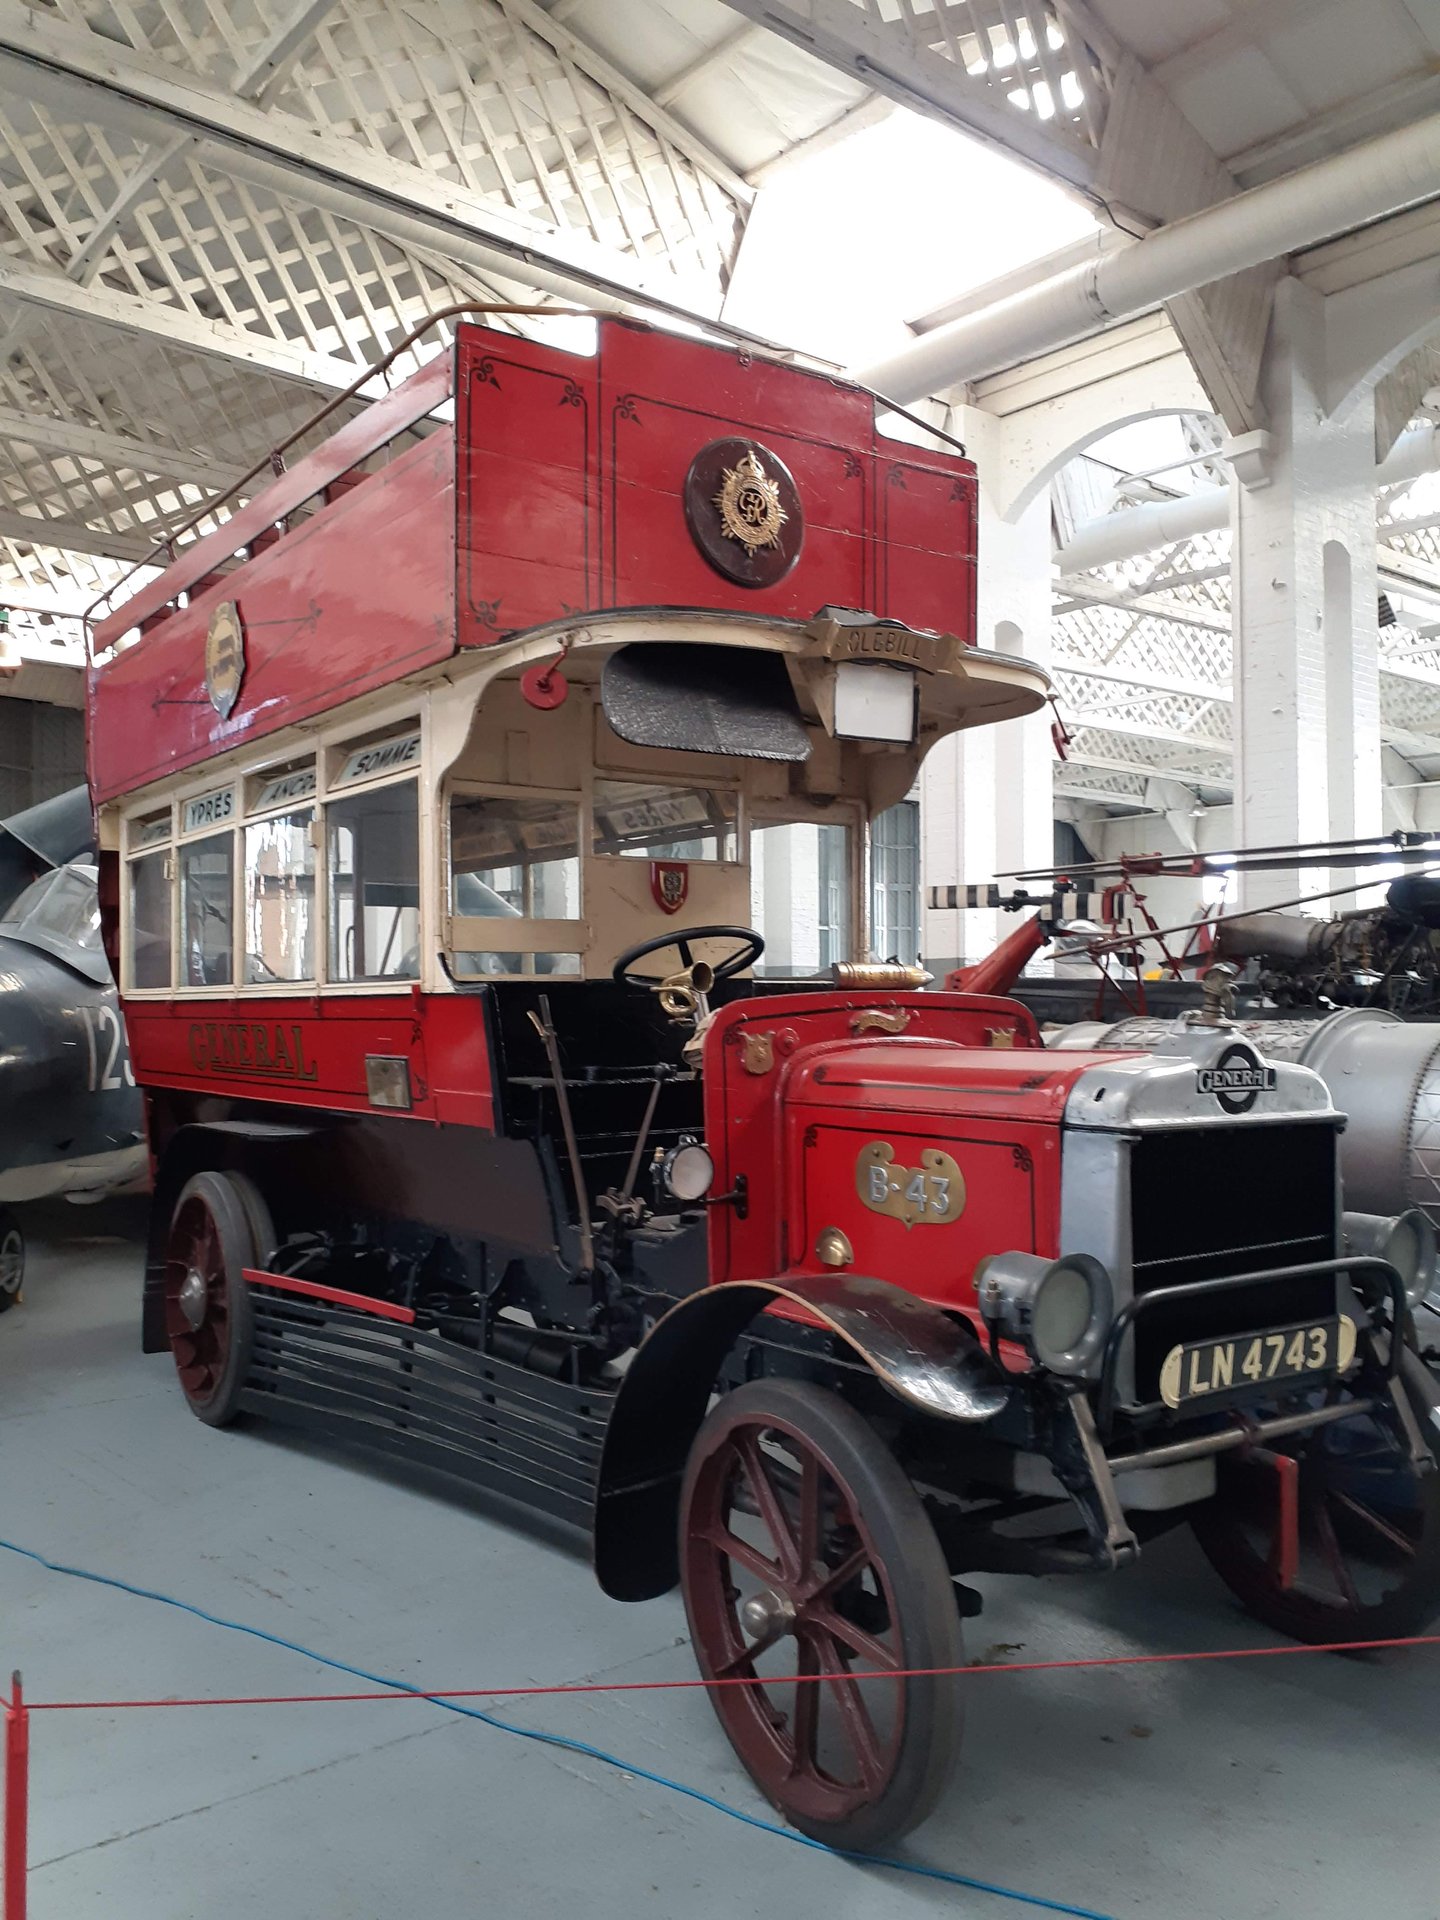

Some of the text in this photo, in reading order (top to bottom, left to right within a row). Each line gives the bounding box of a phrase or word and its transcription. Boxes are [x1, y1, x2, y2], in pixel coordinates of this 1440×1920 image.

[352, 738, 421, 777] SOMME
[190, 792, 232, 827] YPRES
[188, 1023, 319, 1082] GENERAL
[1198, 1068, 1277, 1093] GENERAL
[1188, 1326, 1328, 1395] LN 4743
